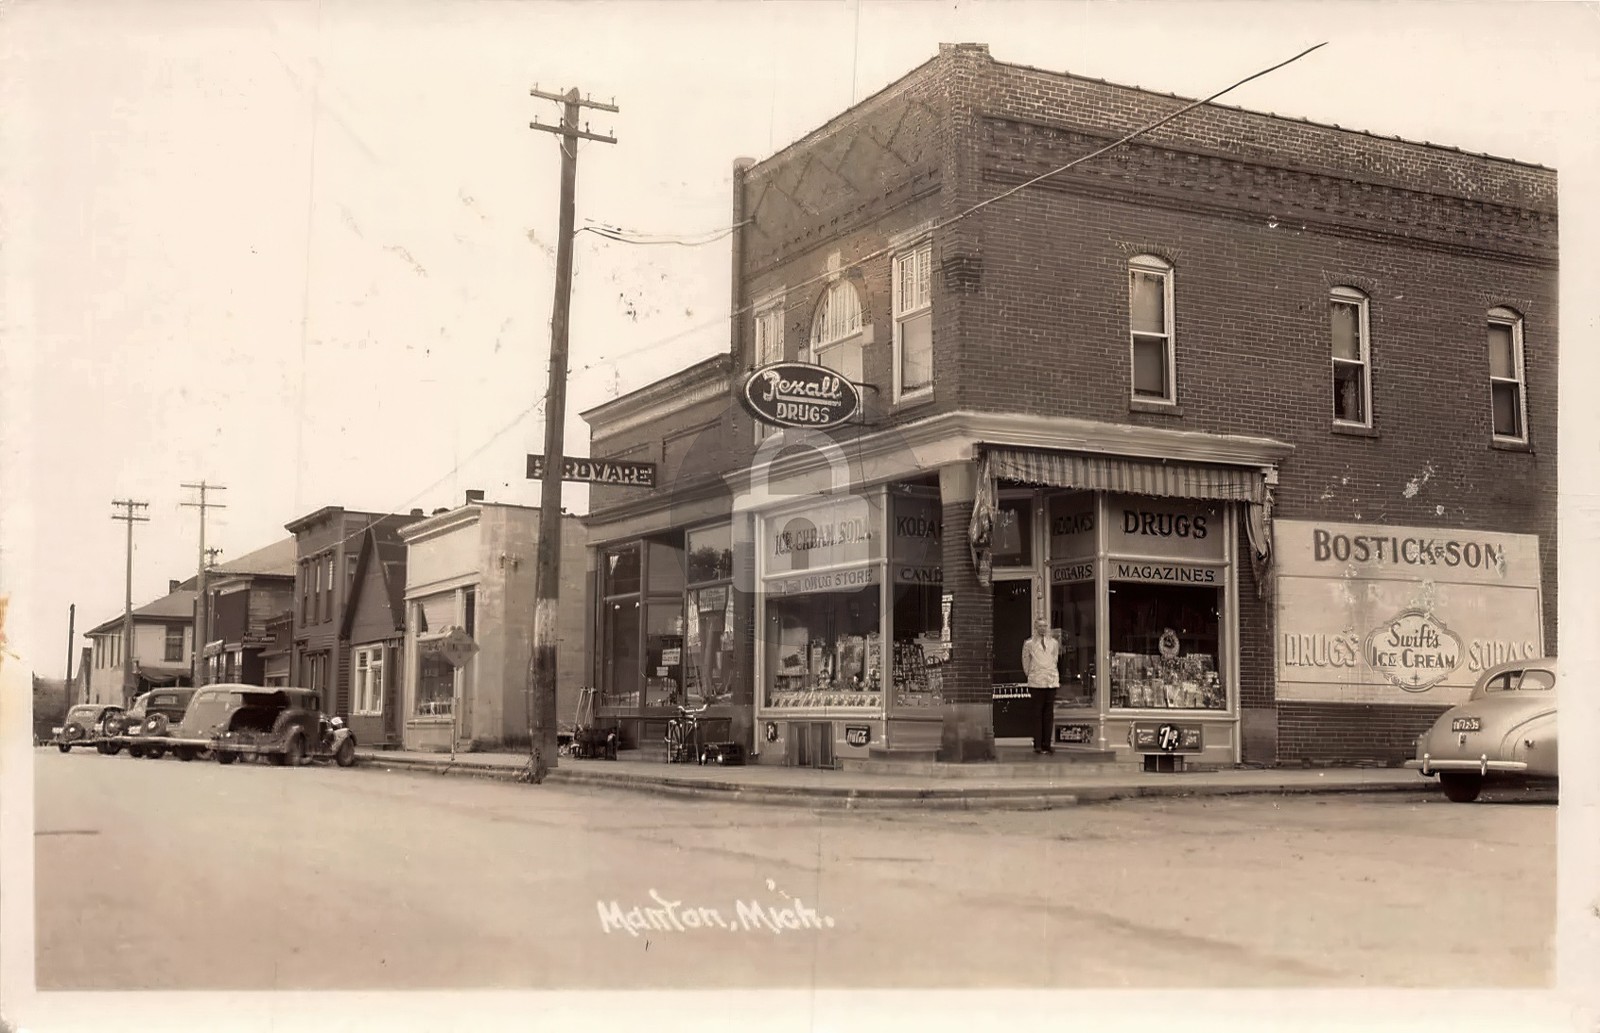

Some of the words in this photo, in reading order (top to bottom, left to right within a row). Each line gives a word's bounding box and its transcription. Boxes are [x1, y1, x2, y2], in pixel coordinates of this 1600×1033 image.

[762, 370, 842, 404] Rexall
[776, 402, 830, 423] DRUGS
[531, 458, 652, 485] HRDWARE
[1122, 509, 1208, 539] DRUGS
[1313, 528, 1437, 566] BOSTICK
[1444, 540, 1503, 570] SON
[834, 568, 873, 586] STORE
[1117, 564, 1215, 583] MAGAZINES
[1387, 623, 1441, 648] Swift's
[1284, 633, 1360, 667] DRUGS
[1372, 646, 1397, 668] ICE
[1402, 648, 1455, 669] CREAM
